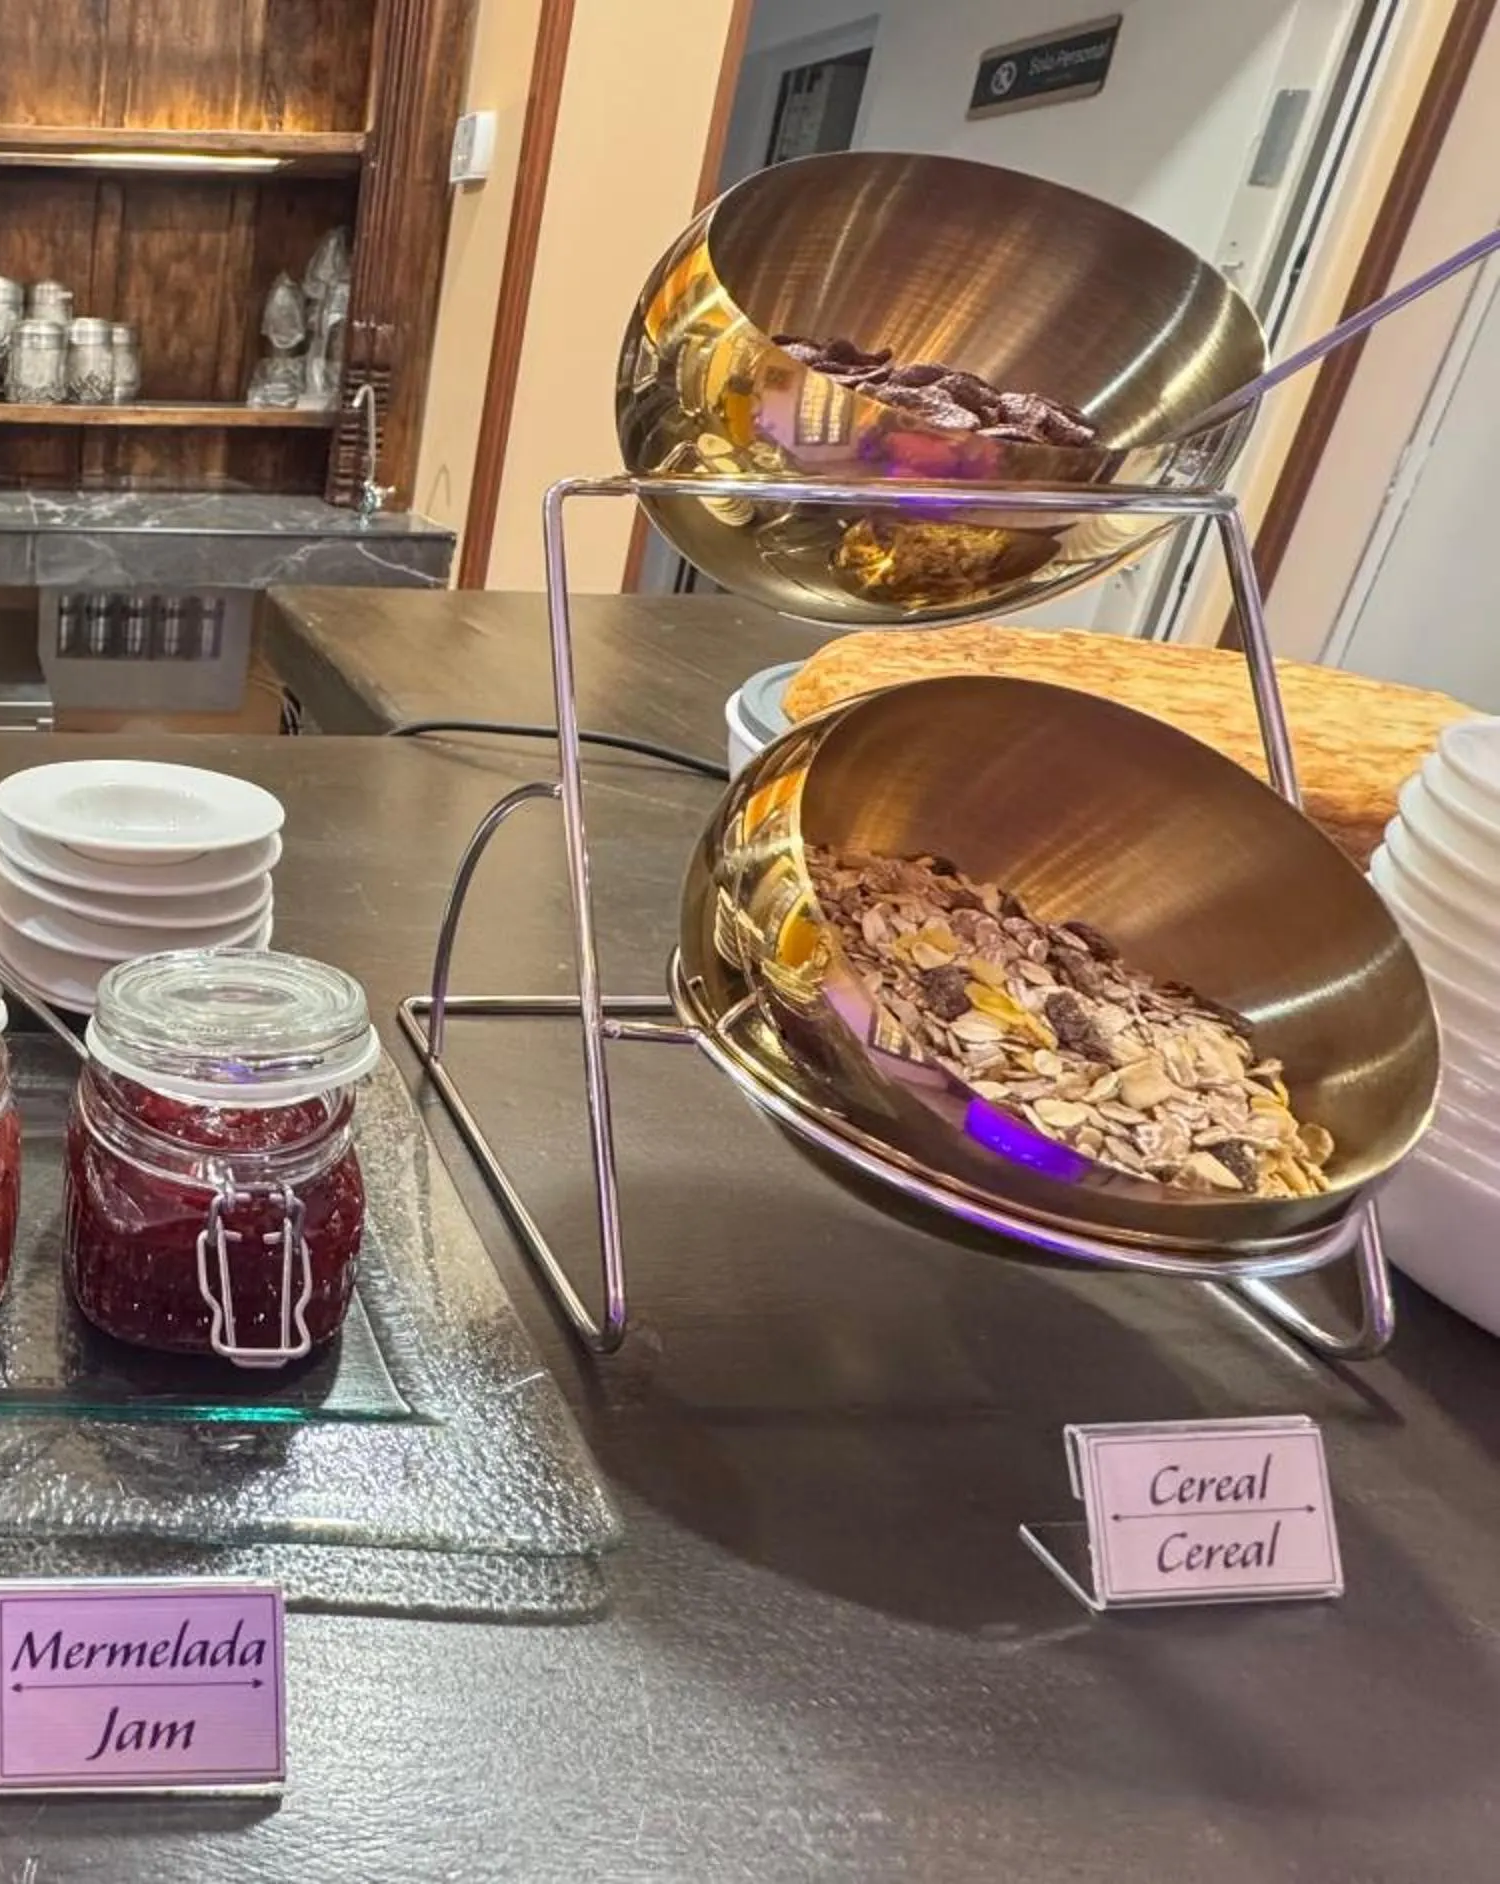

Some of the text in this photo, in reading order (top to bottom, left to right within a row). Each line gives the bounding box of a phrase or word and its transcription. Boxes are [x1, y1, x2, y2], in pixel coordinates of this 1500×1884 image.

[1149, 1453, 1272, 1506] Cereal
[1156, 1520, 1282, 1574] Cereal
[10, 1618, 266, 1672] Mermelada
[85, 1706, 196, 1761] Jam
